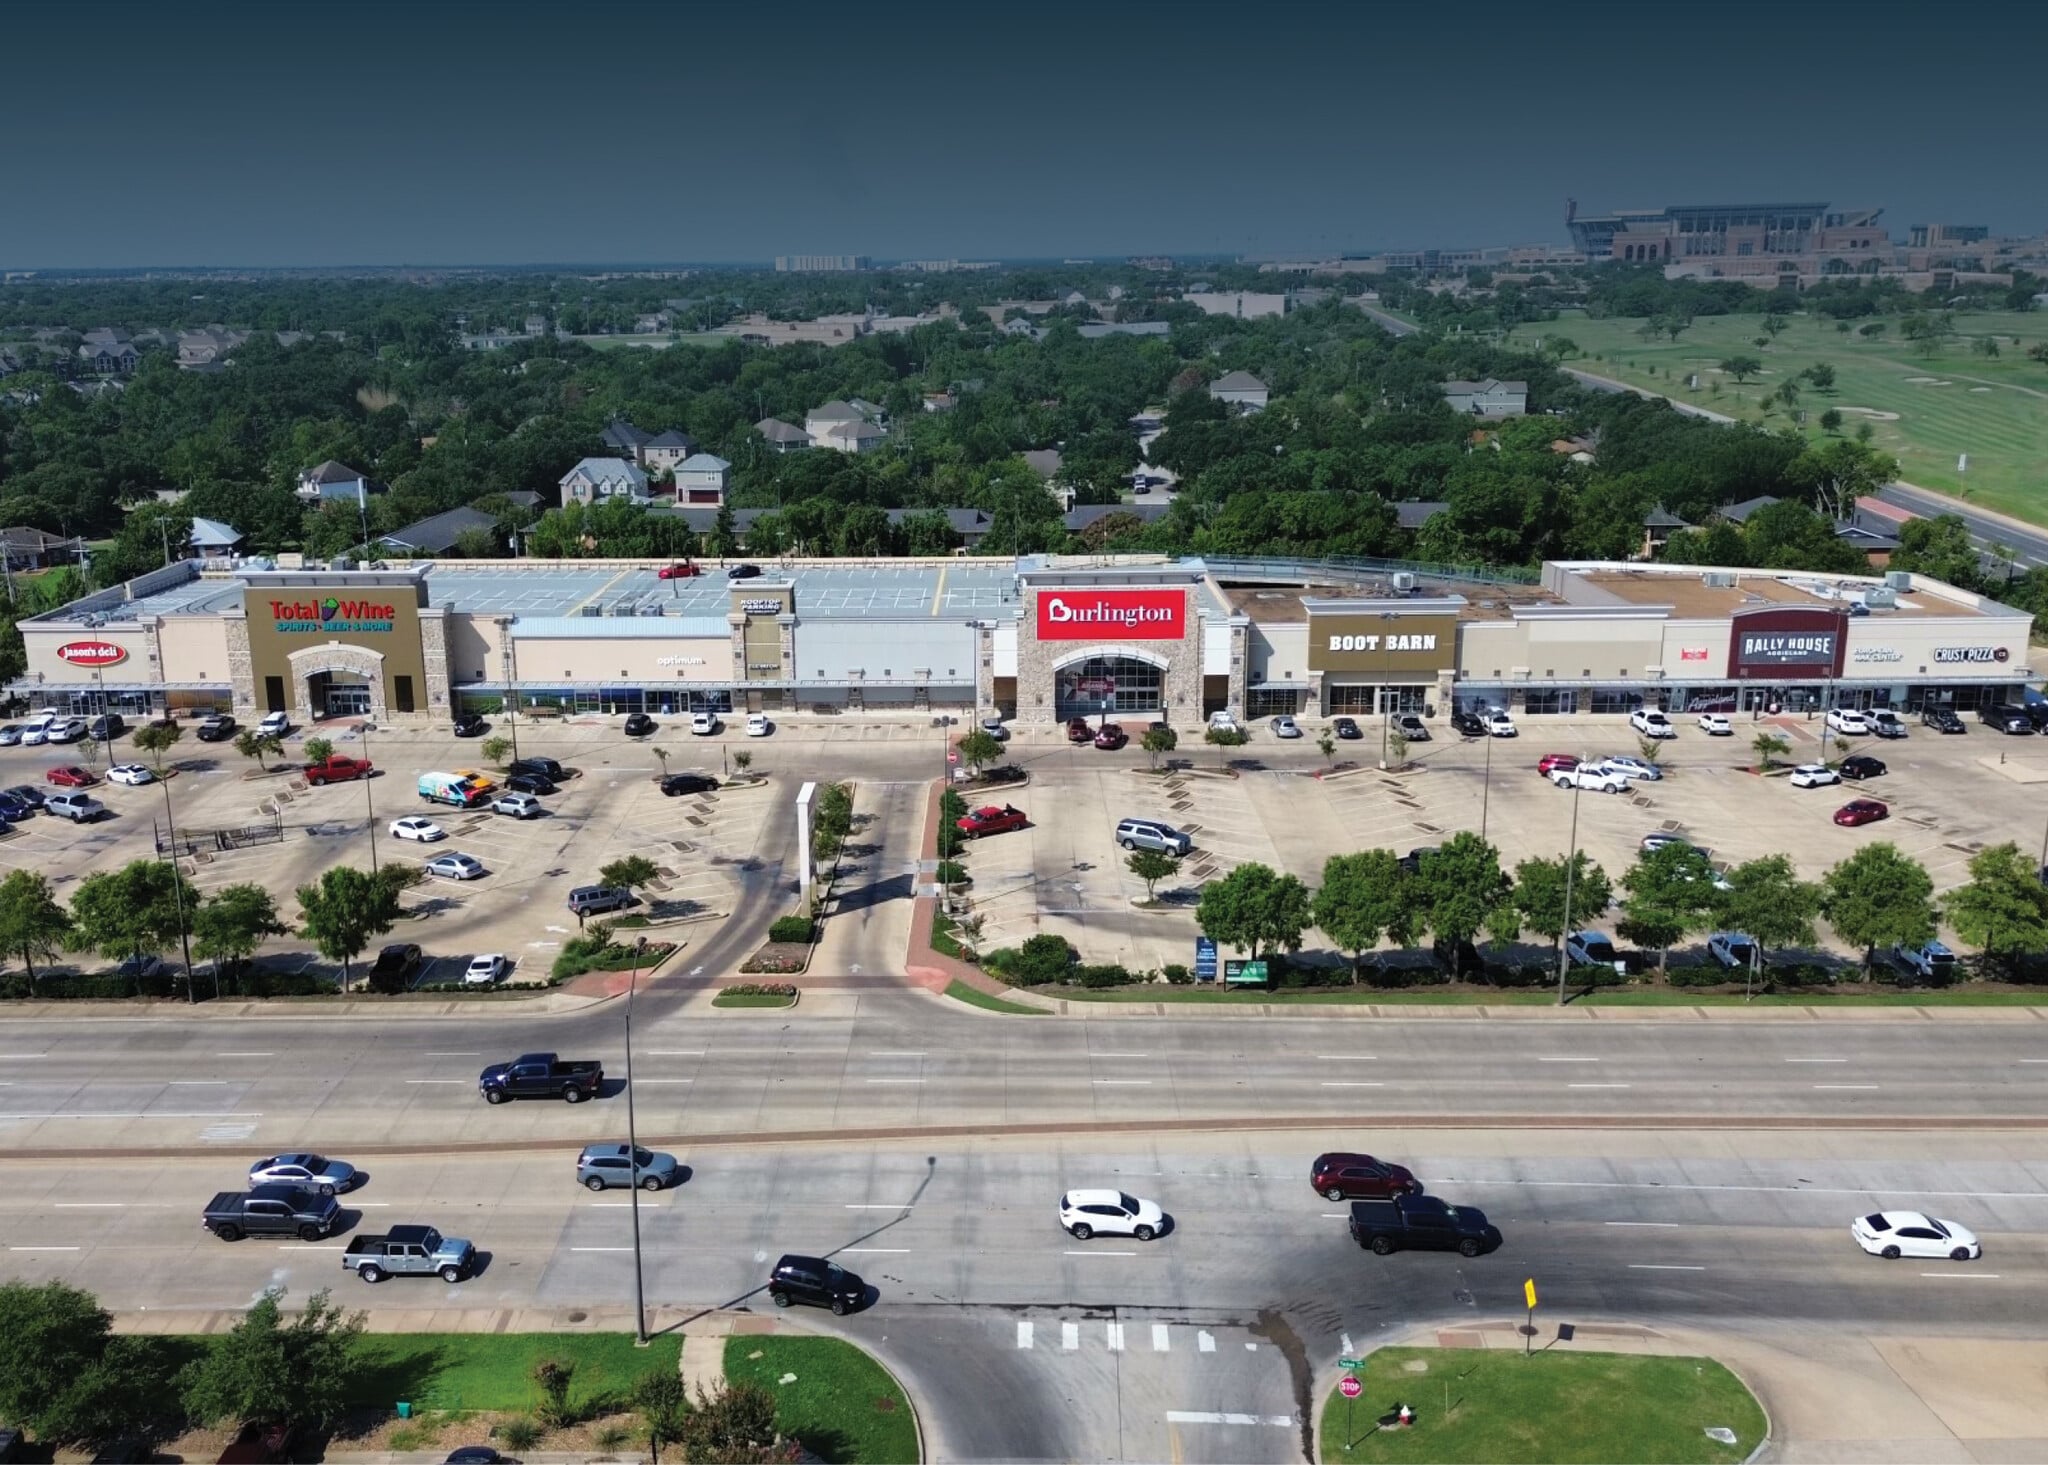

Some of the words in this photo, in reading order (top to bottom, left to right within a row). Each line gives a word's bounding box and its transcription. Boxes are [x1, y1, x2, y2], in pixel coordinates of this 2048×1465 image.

[269, 600, 320, 620] Total
[340, 600, 395, 620] Wine
[1049, 598, 1172, 627] Burlington
[276, 622, 317, 632] SPIRITS
[323, 622, 351, 632] BEER
[362, 622, 393, 632] MORE
[1329, 635, 1379, 651] BOOT
[1385, 635, 1436, 650] BARN
[1745, 638, 1785, 655] RALLY
[1788, 638, 1831, 655] HOUSE
[98, 646, 117, 657] deli
[1934, 648, 1965, 661] CRUST
[1967, 647, 1994, 661] PIZZA
[657, 655, 702, 667] optimum
[1341, 1382, 1360, 1391] STOP
